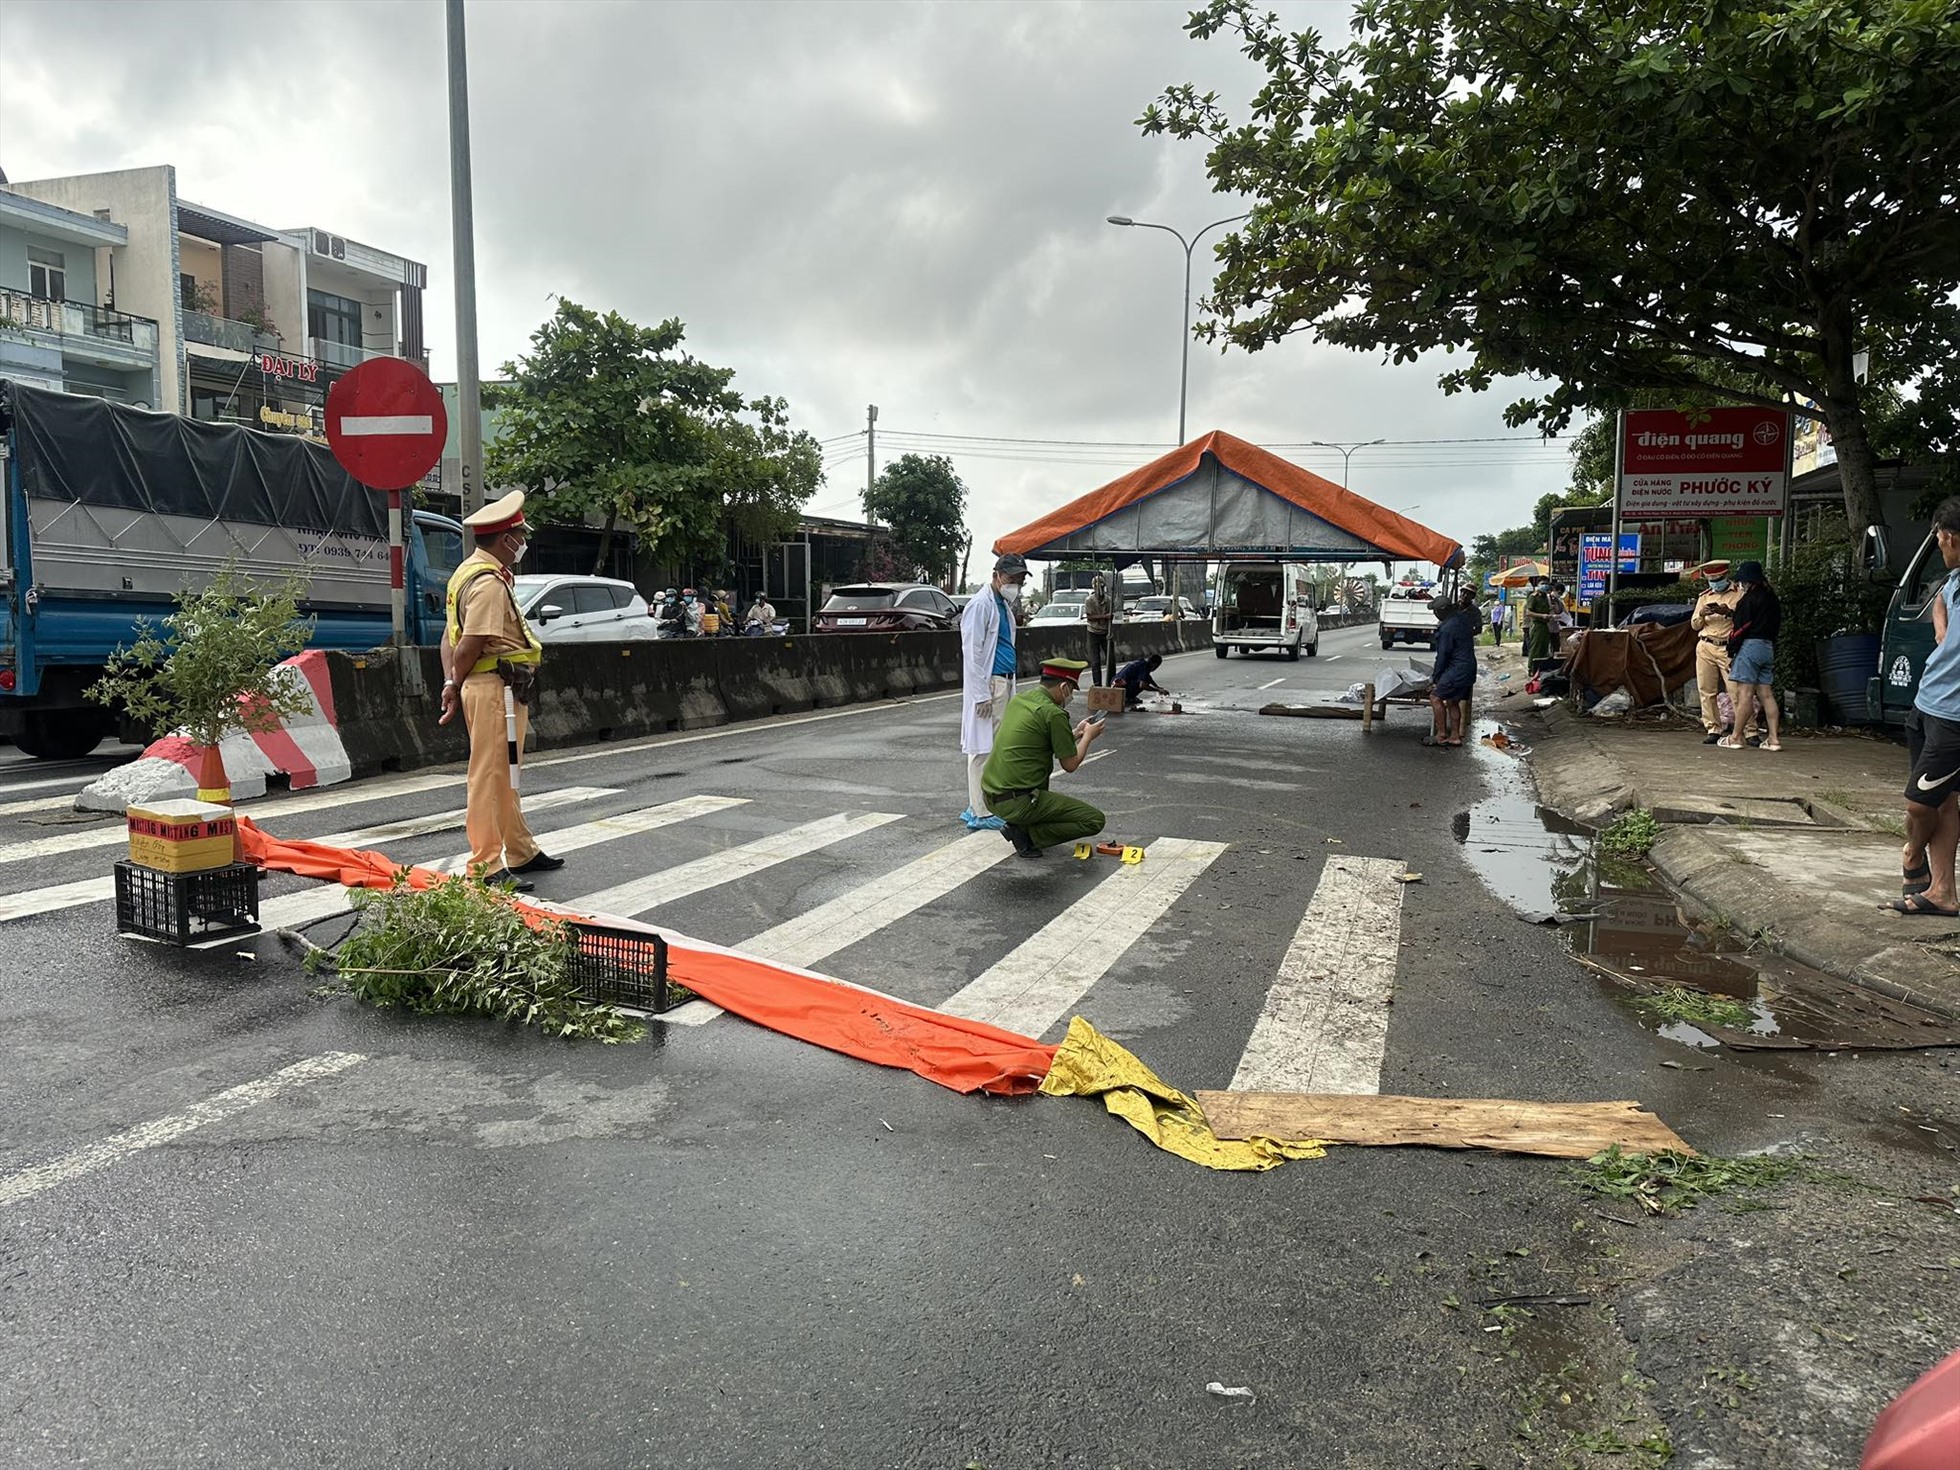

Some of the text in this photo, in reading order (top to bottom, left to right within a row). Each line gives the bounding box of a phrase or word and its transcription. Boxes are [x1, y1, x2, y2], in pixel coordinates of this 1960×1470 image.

[261, 354, 318, 382] ĐẠI LÝ
[1632, 431, 1744, 450] điện quang
[1633, 478, 1648, 486] CỬA
[1680, 476, 1773, 494] PHƯỚC KÝ
[324, 546, 351, 557] 0939
[1081, 845, 1138, 858] 1 2
